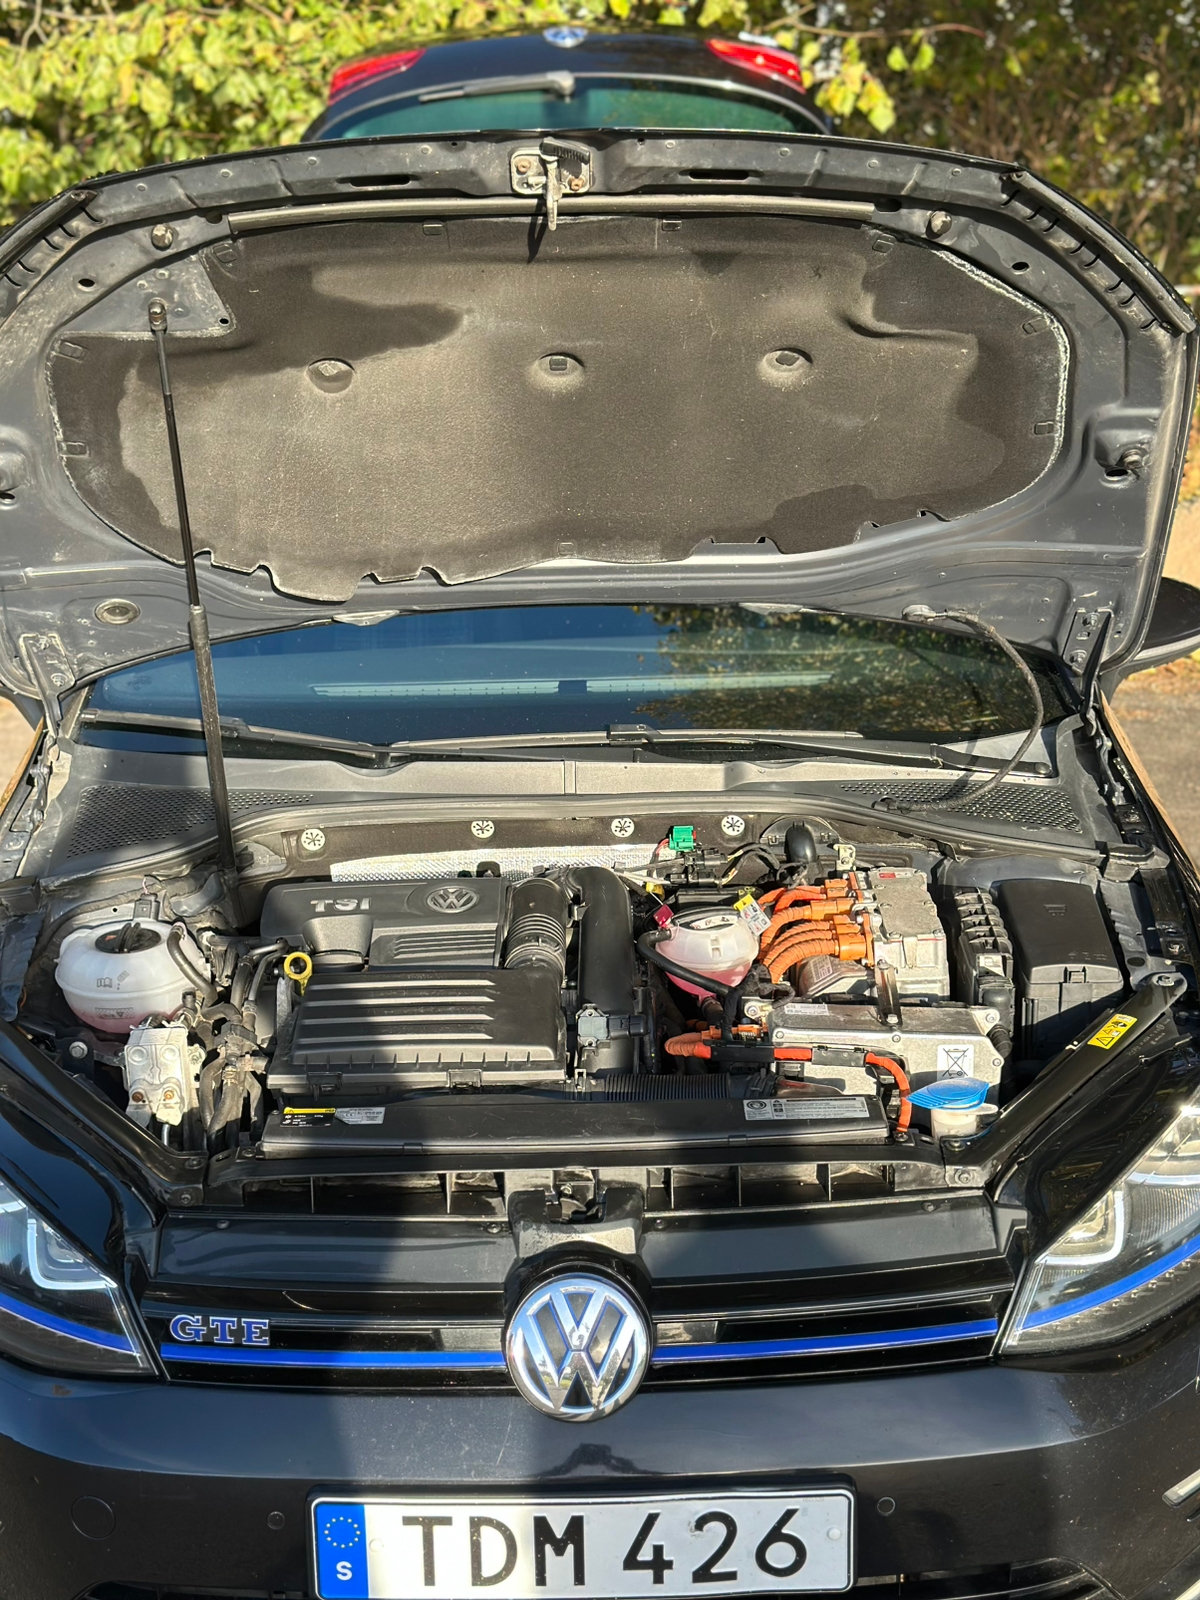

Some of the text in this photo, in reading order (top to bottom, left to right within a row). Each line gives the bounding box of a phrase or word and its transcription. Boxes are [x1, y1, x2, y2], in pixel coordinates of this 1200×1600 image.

[310, 897, 372, 912] TSI
[170, 1314, 270, 1345] GTE
[506, 1273, 650, 1420] VW
[402, 1507, 808, 1588] TDM 426
[336, 1560, 353, 1581] S
